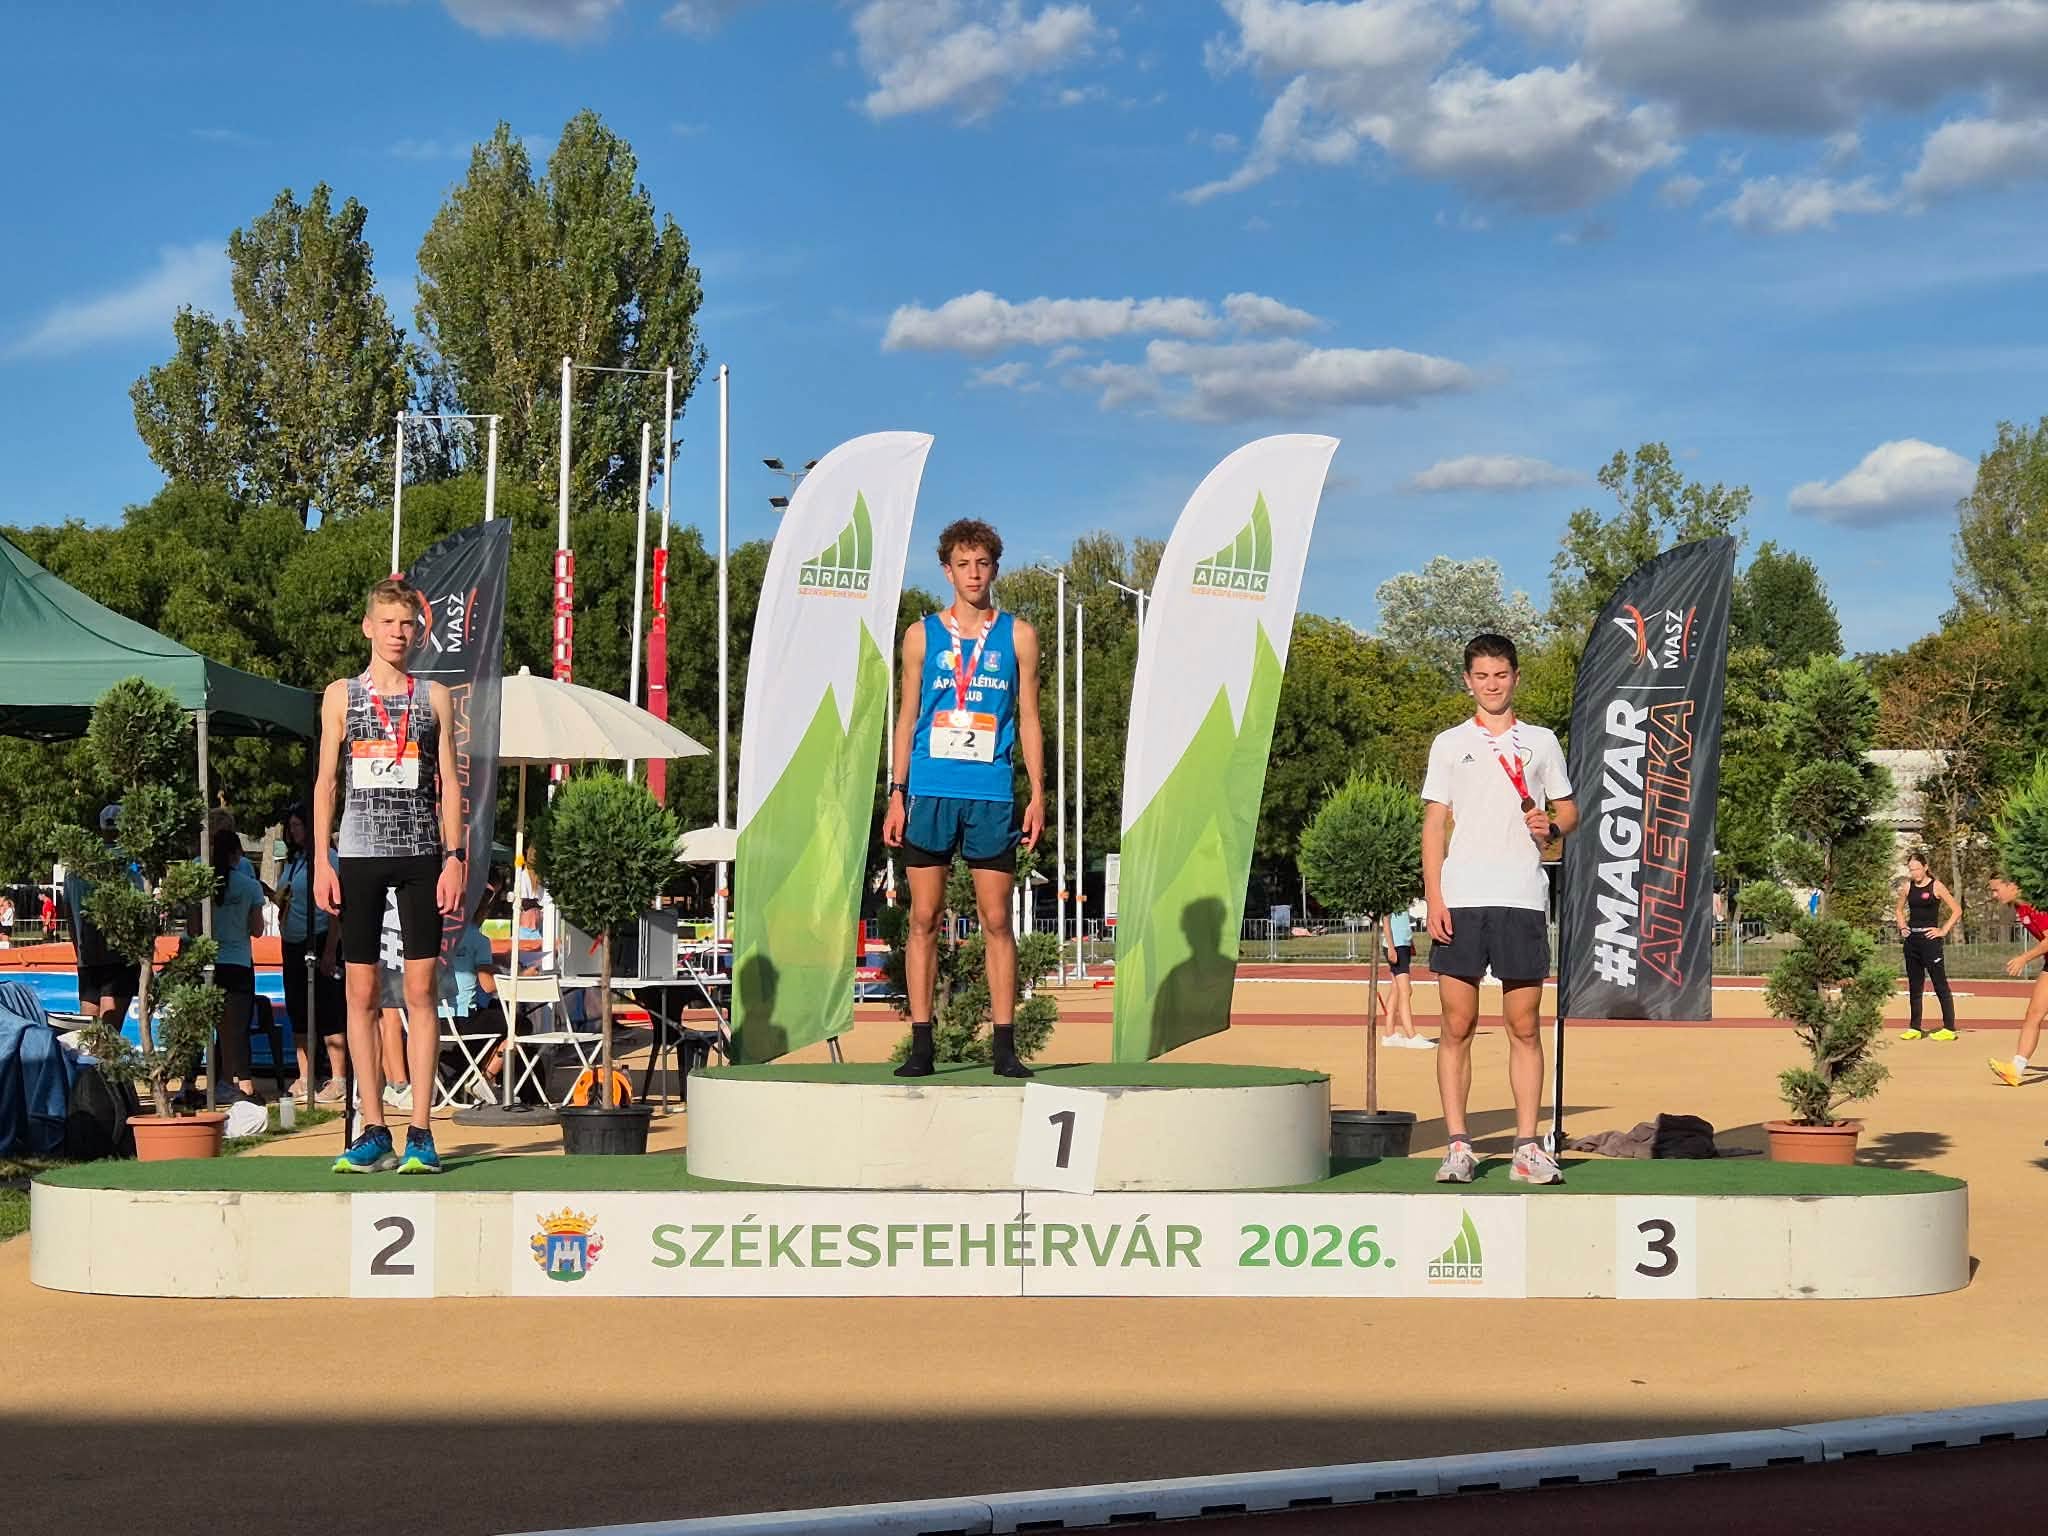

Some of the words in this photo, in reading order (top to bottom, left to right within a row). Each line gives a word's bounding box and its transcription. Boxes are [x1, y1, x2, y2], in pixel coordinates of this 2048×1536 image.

[802, 570, 868, 589] ARAK
[1195, 570, 1266, 591] ARAK
[446, 591, 465, 653] MASZ
[1663, 608, 1684, 669] MASZ
[964, 691, 983, 702] LUB
[1594, 699, 1649, 987] #MAGYAR
[1639, 700, 1695, 987] ATLETIKA
[1047, 1110, 1076, 1169] 1
[371, 1216, 416, 1276] 2
[652, 1213, 1204, 1269] SZÉKESFEHÉRVÁR
[1239, 1223, 1397, 1269] 2026.
[1635, 1219, 1680, 1278] 3
[1428, 1265, 1482, 1278] ARAK
